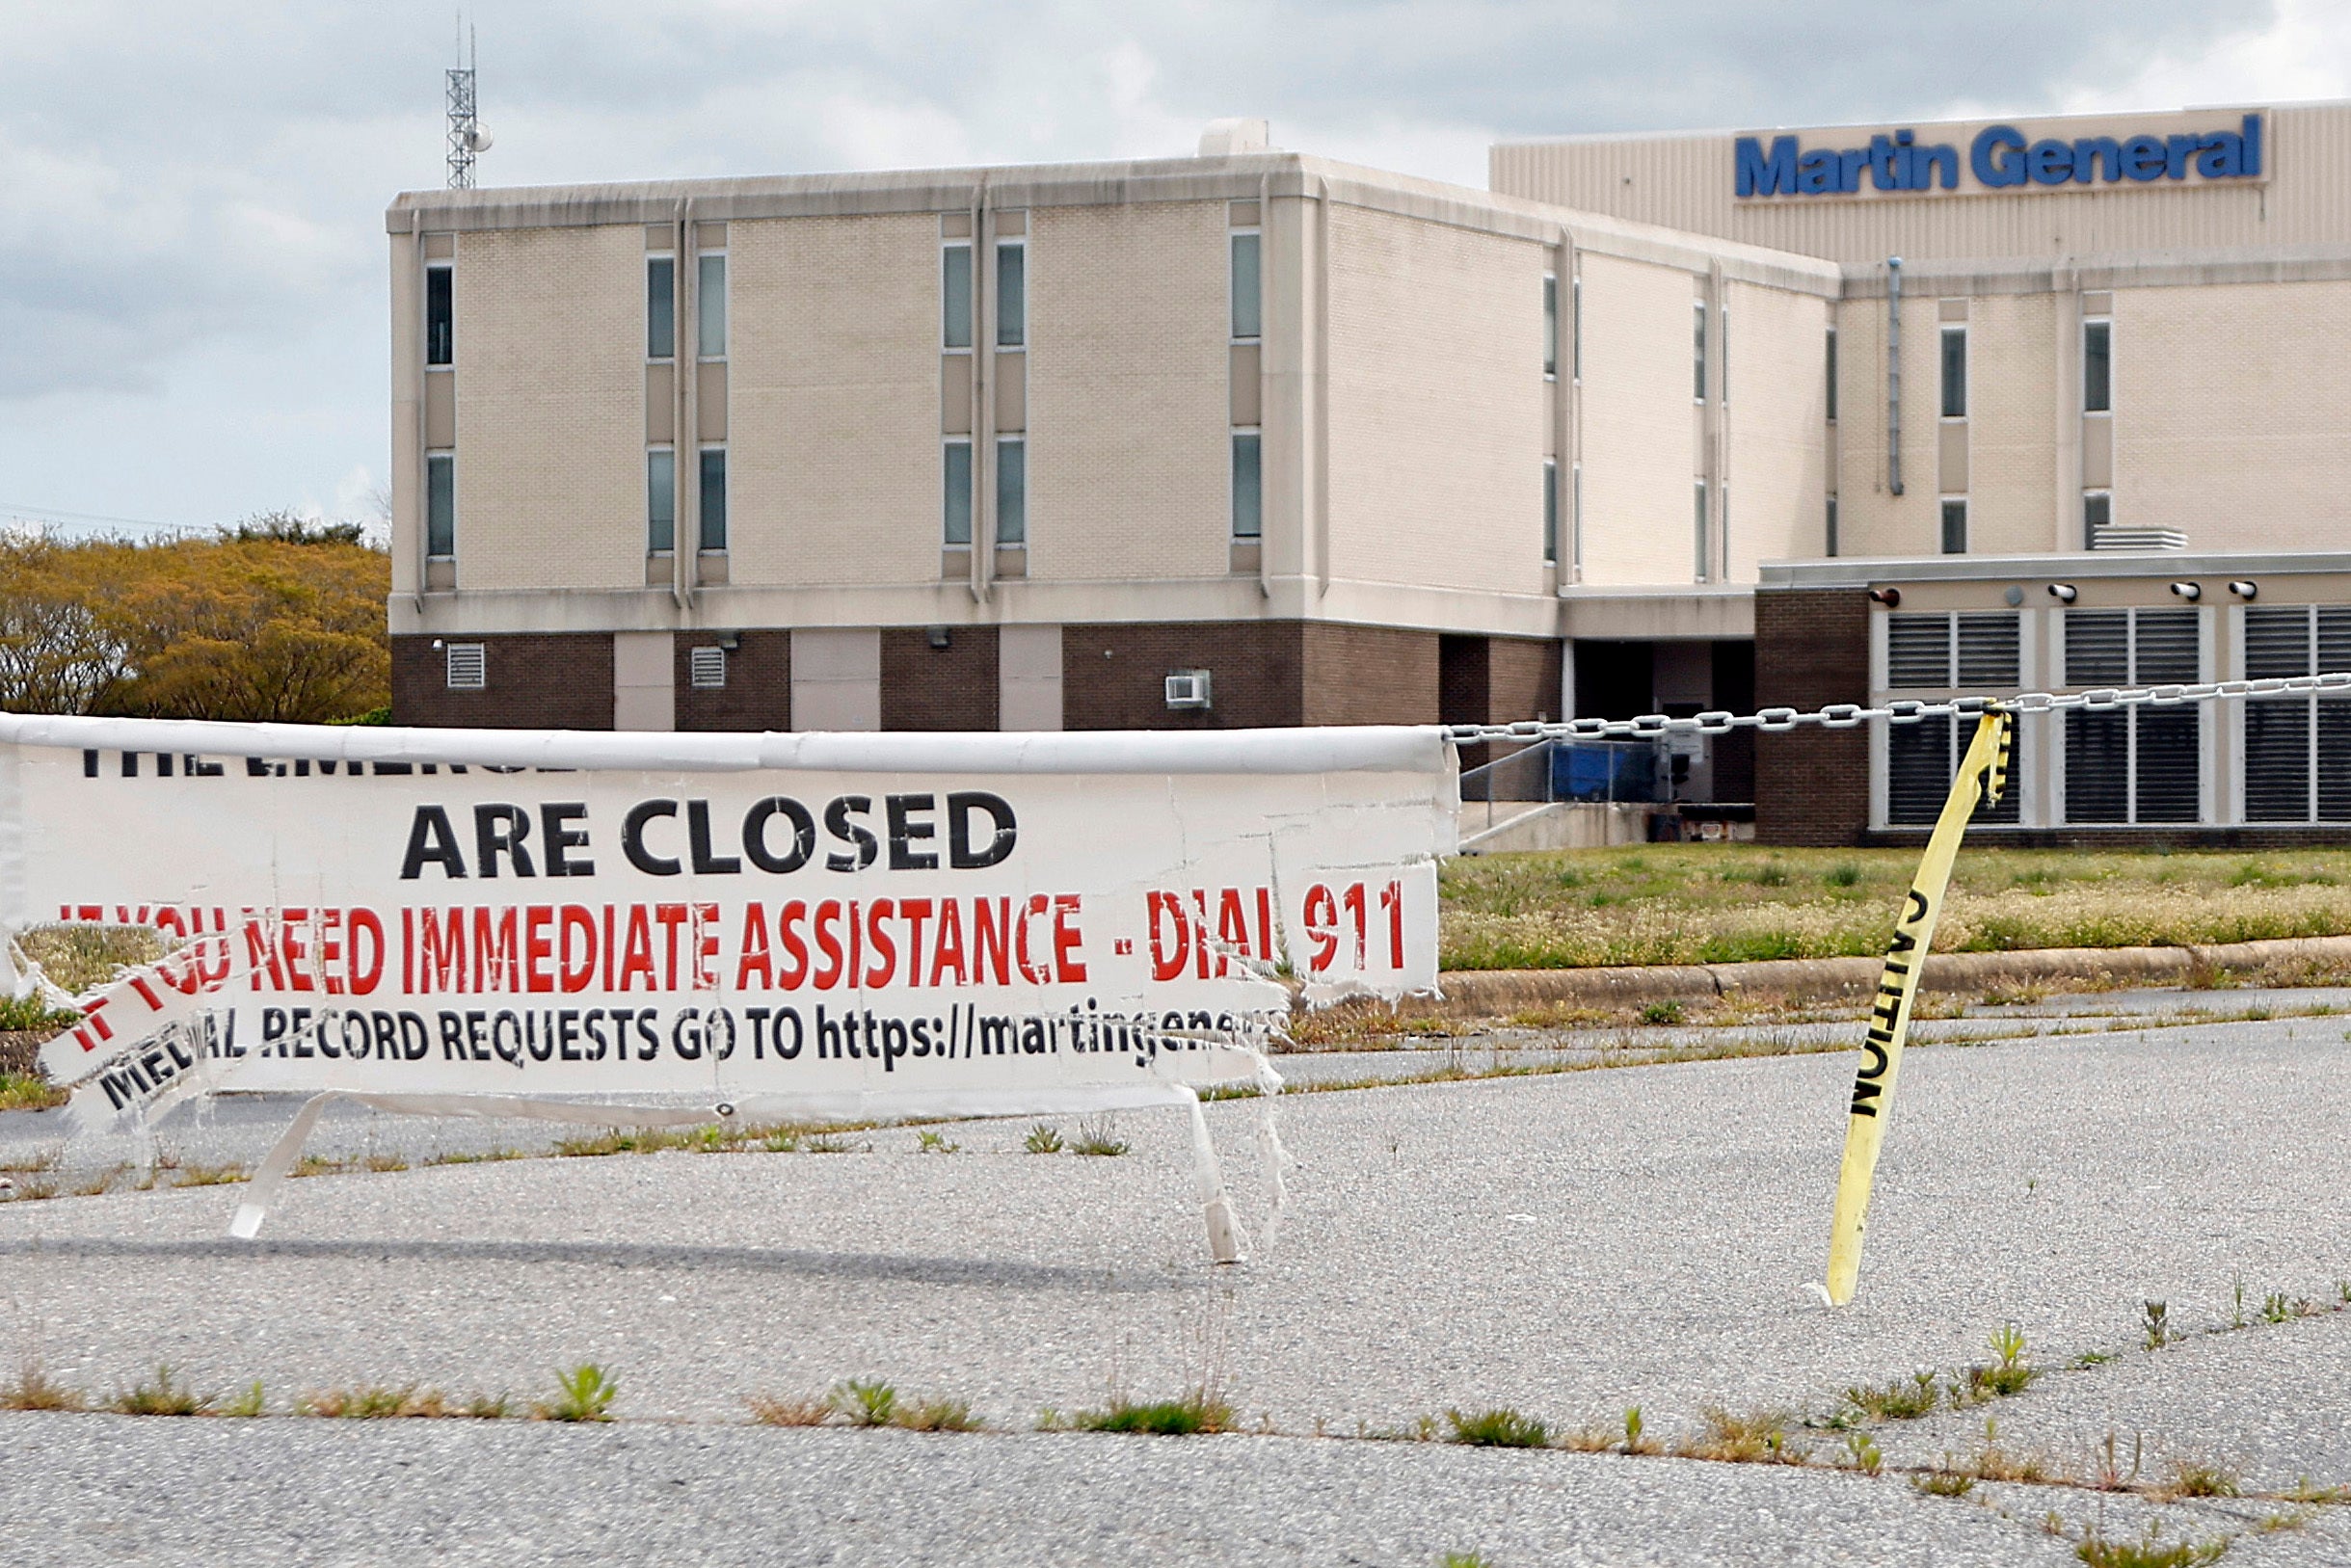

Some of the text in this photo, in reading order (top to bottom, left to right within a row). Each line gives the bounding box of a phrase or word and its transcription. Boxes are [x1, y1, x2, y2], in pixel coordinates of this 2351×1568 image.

[1735, 114, 2261, 197] Martin General
[399, 791, 1017, 879] ARE CLOSED
[241, 907, 385, 996] NEED
[401, 902, 721, 995] IMMEDIATE
[735, 892, 1088, 992] ASSISTANCE
[1303, 880, 1404, 972] 911
[261, 1006, 429, 1060] RECORD
[439, 1007, 659, 1070] REQUESTS
[672, 1005, 736, 1061] GO
[746, 1006, 803, 1060] TO
